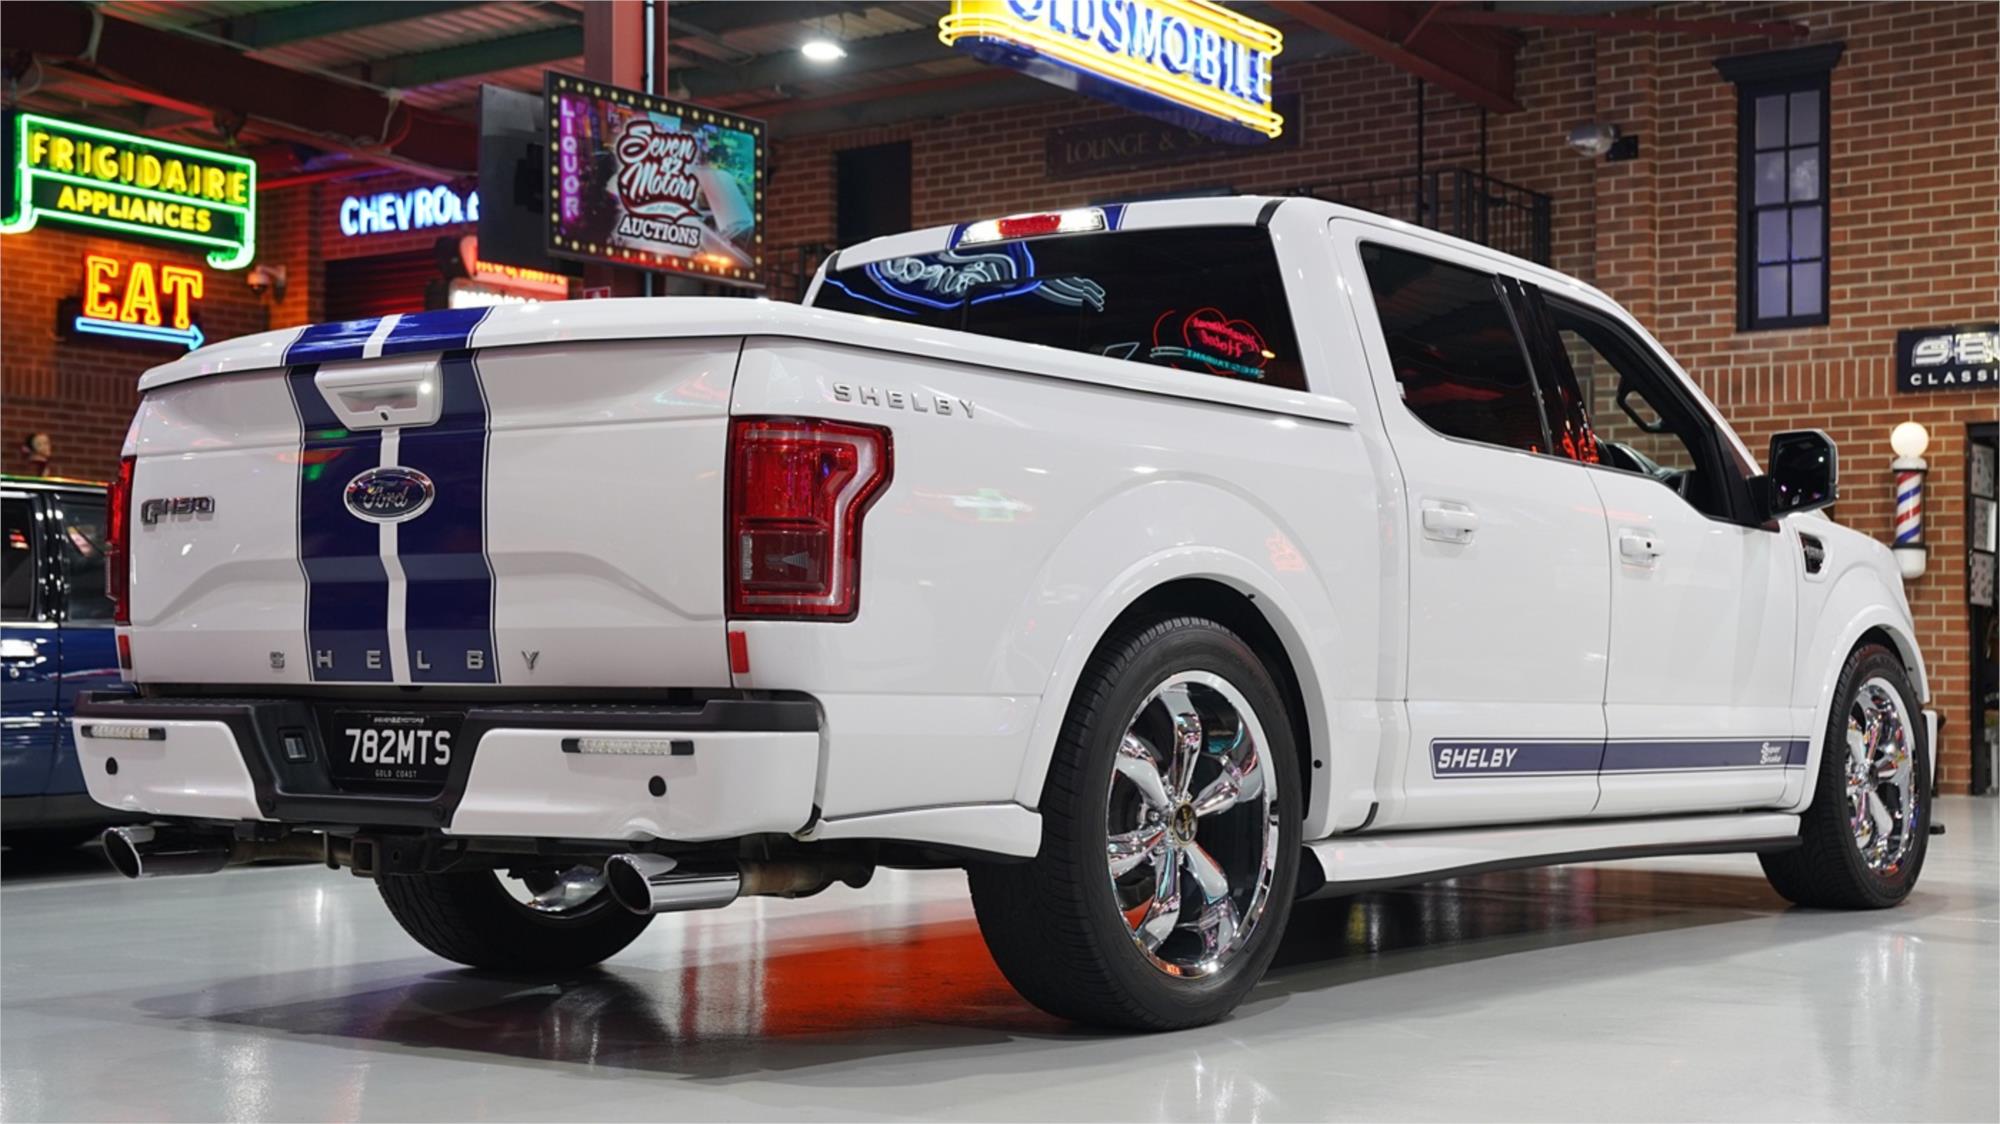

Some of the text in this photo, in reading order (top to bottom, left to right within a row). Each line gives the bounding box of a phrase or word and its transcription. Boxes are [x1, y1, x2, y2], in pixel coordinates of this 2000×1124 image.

[561, 98, 579, 218] LIQUOR
[619, 124, 694, 164] Seven
[1065, 131, 1151, 164] LOUNGE
[1159, 132, 1176, 151] &
[29, 132, 248, 204] FRIGIDAIRE
[621, 162, 696, 200] Motors
[57, 185, 212, 233] APPLIANCES
[619, 215, 699, 247] AUCTIONS
[85, 255, 204, 330] EAT
[833, 383, 976, 419] SHELBY
[363, 486, 409, 509] Ford
[269, 650, 540, 670] SHELBY
[345, 728, 451, 765] 782MTS
[1437, 748, 1518, 768] SHELBY
[375, 769, 417, 779] GOLD COAST
